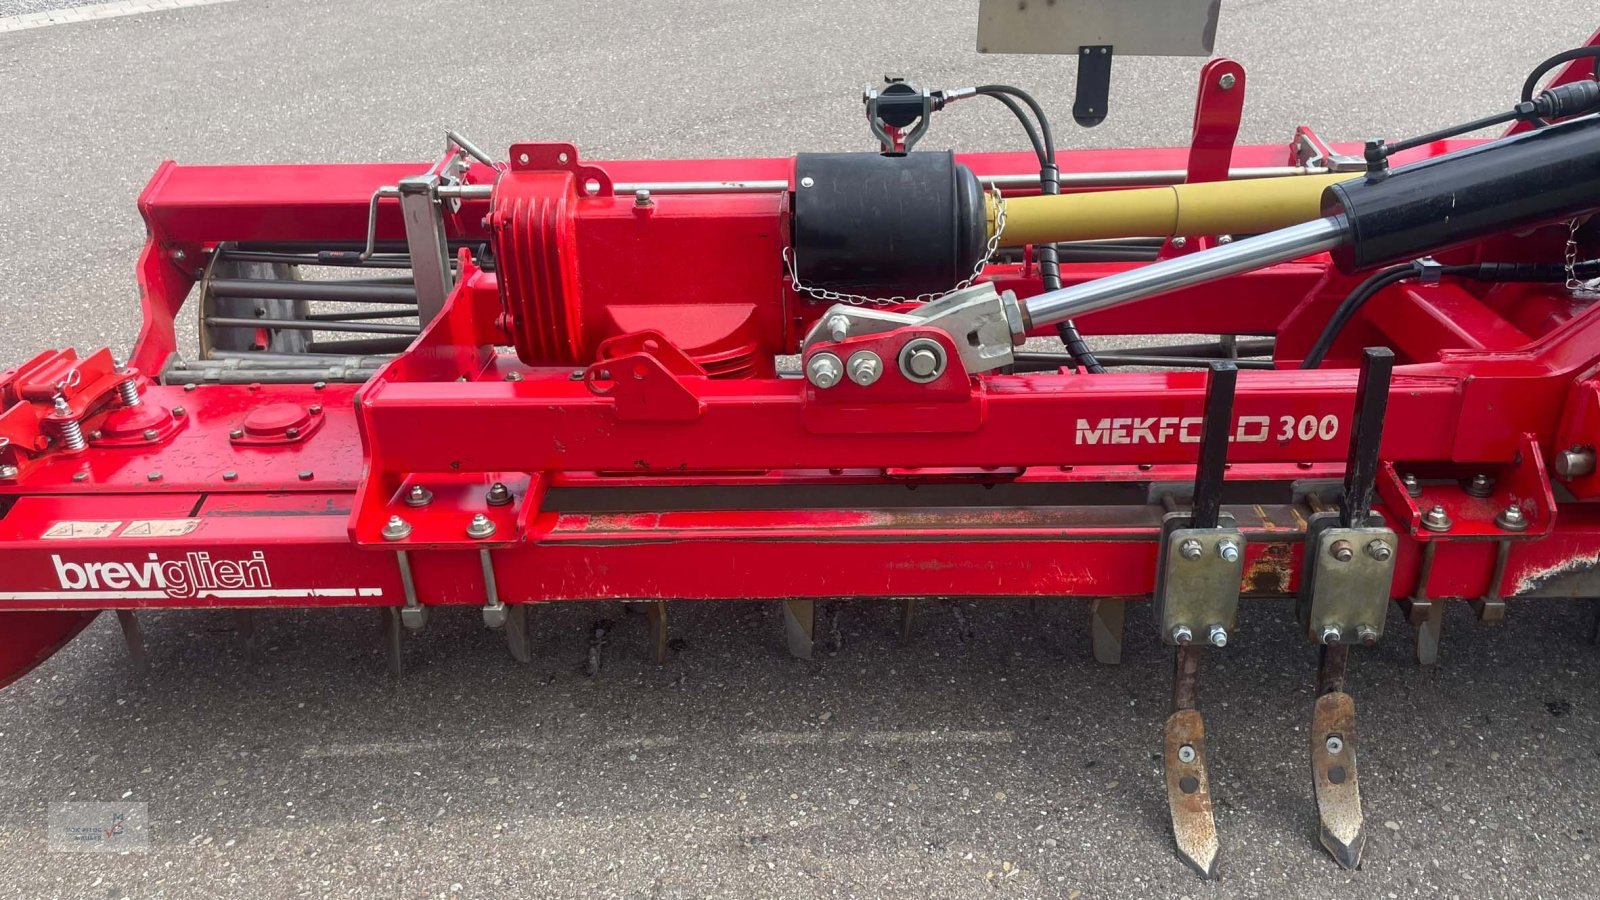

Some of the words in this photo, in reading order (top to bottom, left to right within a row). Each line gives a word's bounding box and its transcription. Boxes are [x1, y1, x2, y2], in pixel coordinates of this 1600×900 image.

[1075, 415, 1270, 444] MEKFOD
[1277, 414, 1339, 441] 300
[52, 551, 272, 598] breviglieri
